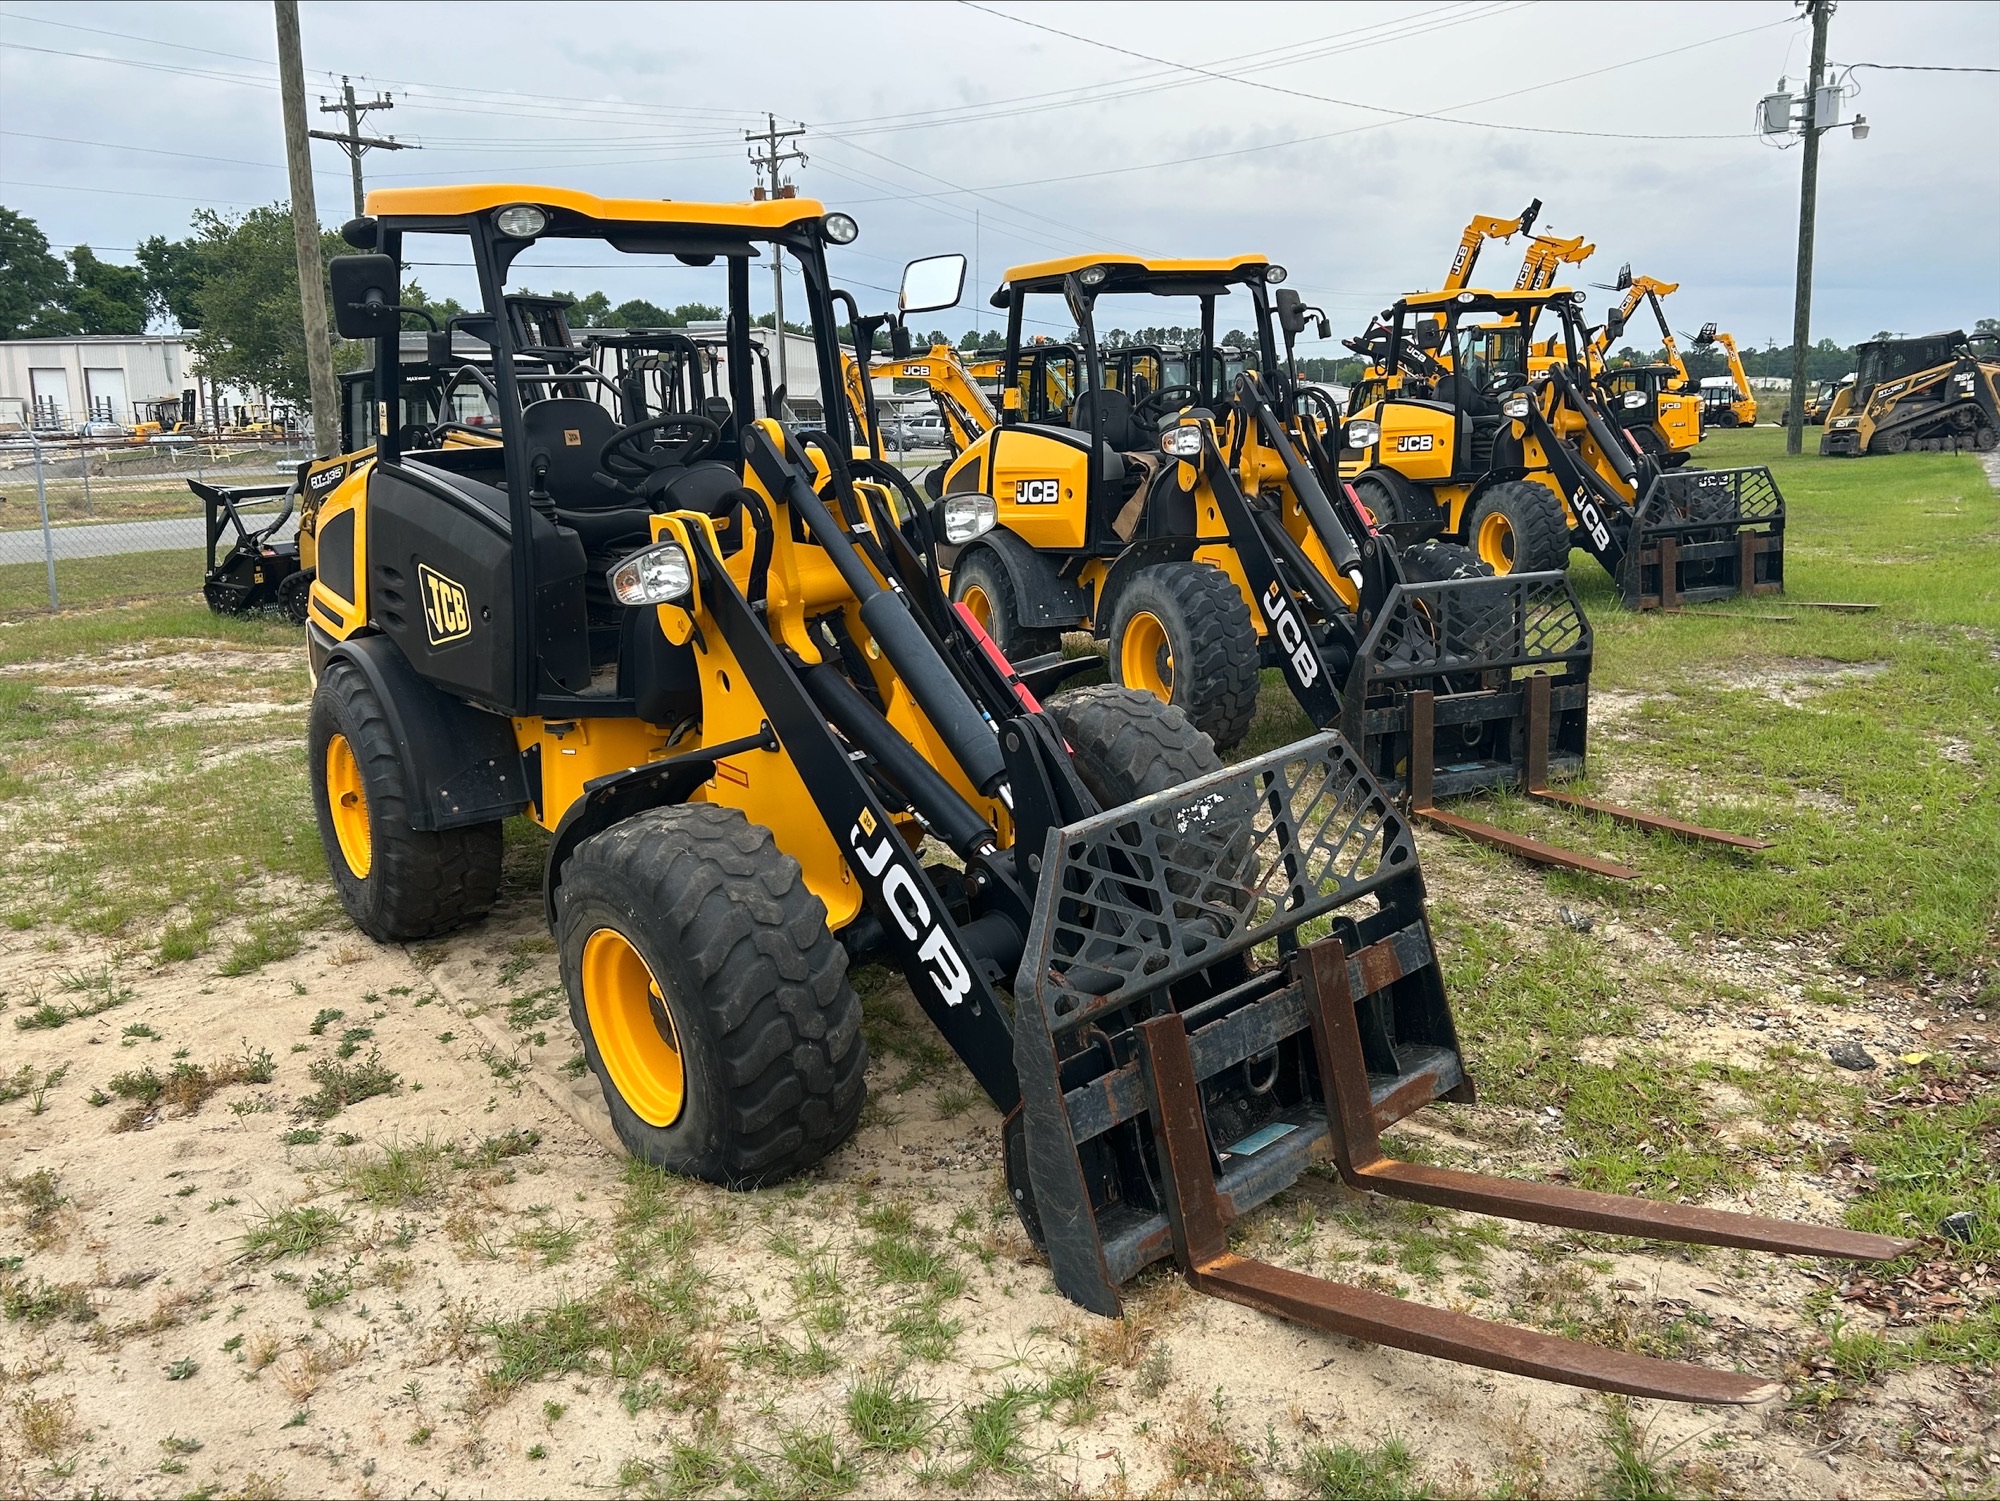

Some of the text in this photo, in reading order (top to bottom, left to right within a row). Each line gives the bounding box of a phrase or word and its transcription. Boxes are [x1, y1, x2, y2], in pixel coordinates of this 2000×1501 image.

[1453, 245, 1468, 275] JCB
[1517, 262, 1532, 289] JCB
[1406, 347, 1427, 363] JCB
[903, 366, 930, 375] JCB
[1531, 370, 1550, 379] JC
[1397, 436, 1432, 451] JCB
[311, 468, 342, 488] RT-135
[1016, 480, 1058, 503] JCB
[1573, 492, 1610, 552] JCB
[427, 574, 467, 634] JCB
[1263, 590, 1318, 688] JCB
[850, 823, 972, 1008] JCB
